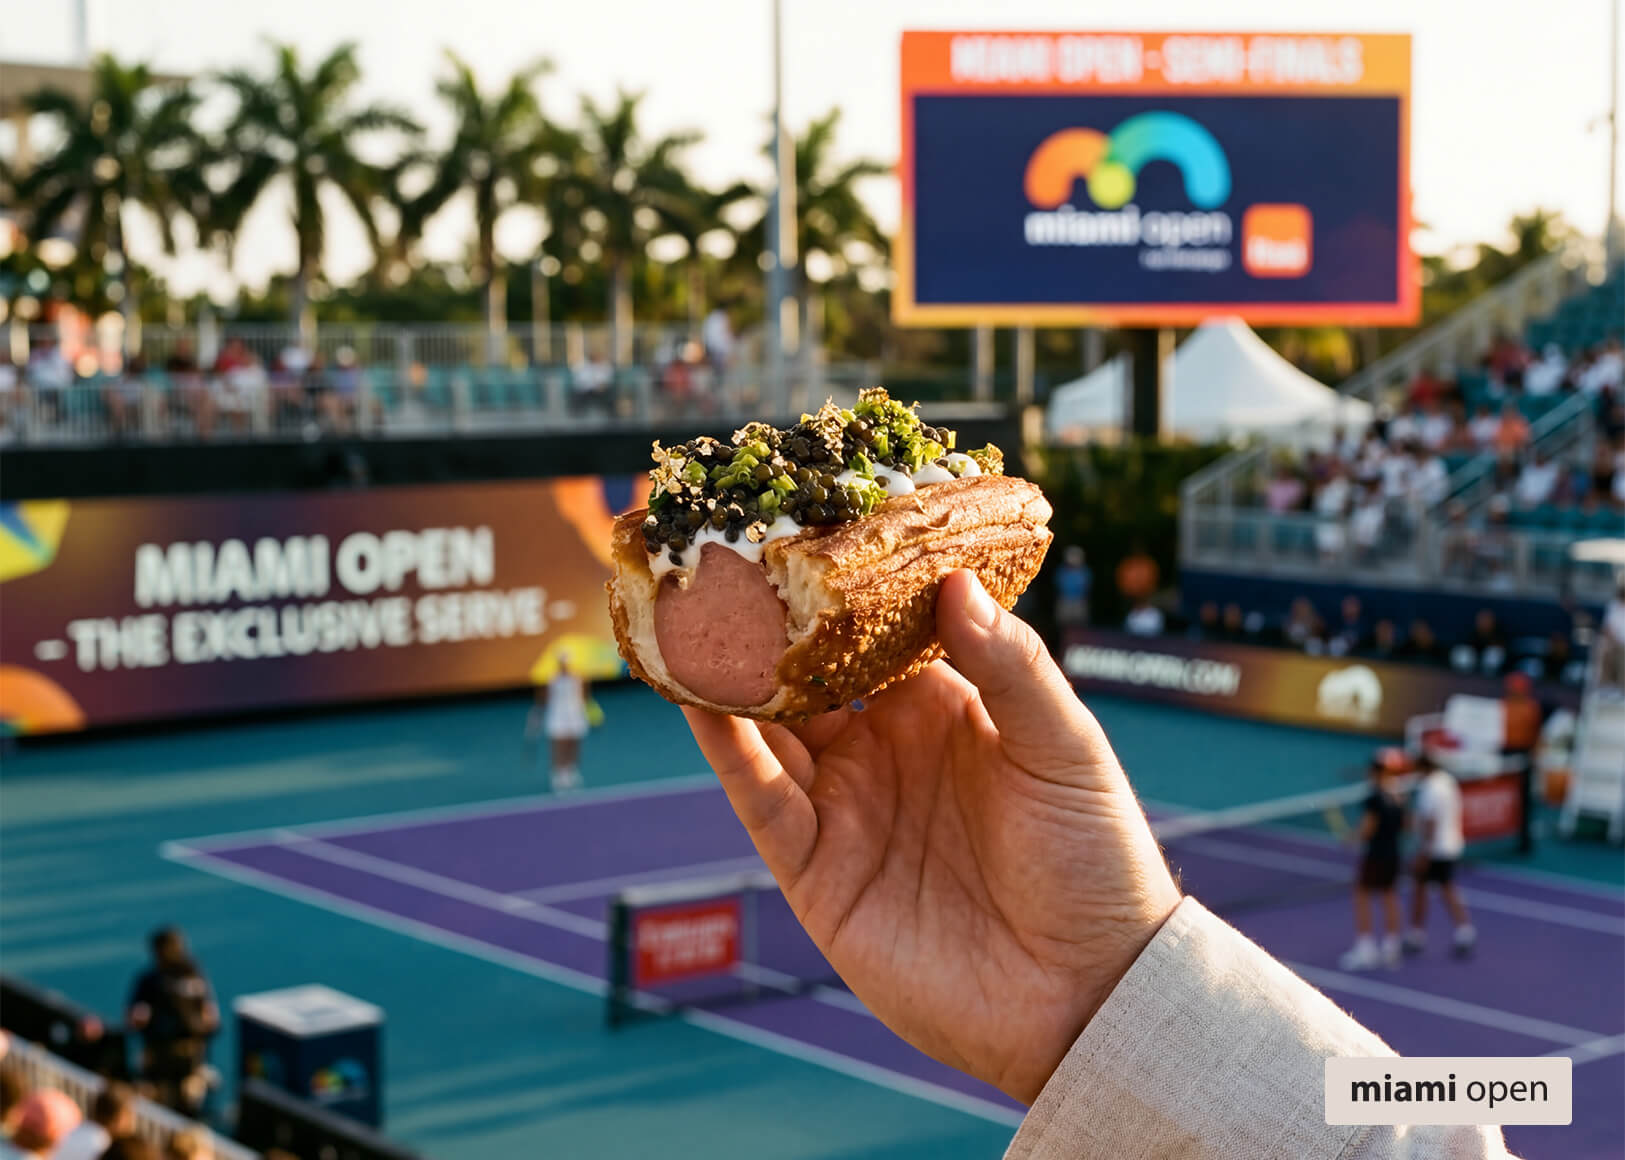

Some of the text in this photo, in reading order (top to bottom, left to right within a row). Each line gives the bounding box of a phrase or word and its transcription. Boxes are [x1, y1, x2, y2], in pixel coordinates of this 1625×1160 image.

[1055, 35, 1144, 84] OPEN
[1025, 204, 1232, 251] miami open
[134, 525, 496, 608] MIAMI OPEN
[68, 614, 169, 672] THE
[172, 595, 414, 665] EXCLUSIVE
[416, 586, 548, 644] SERVE
